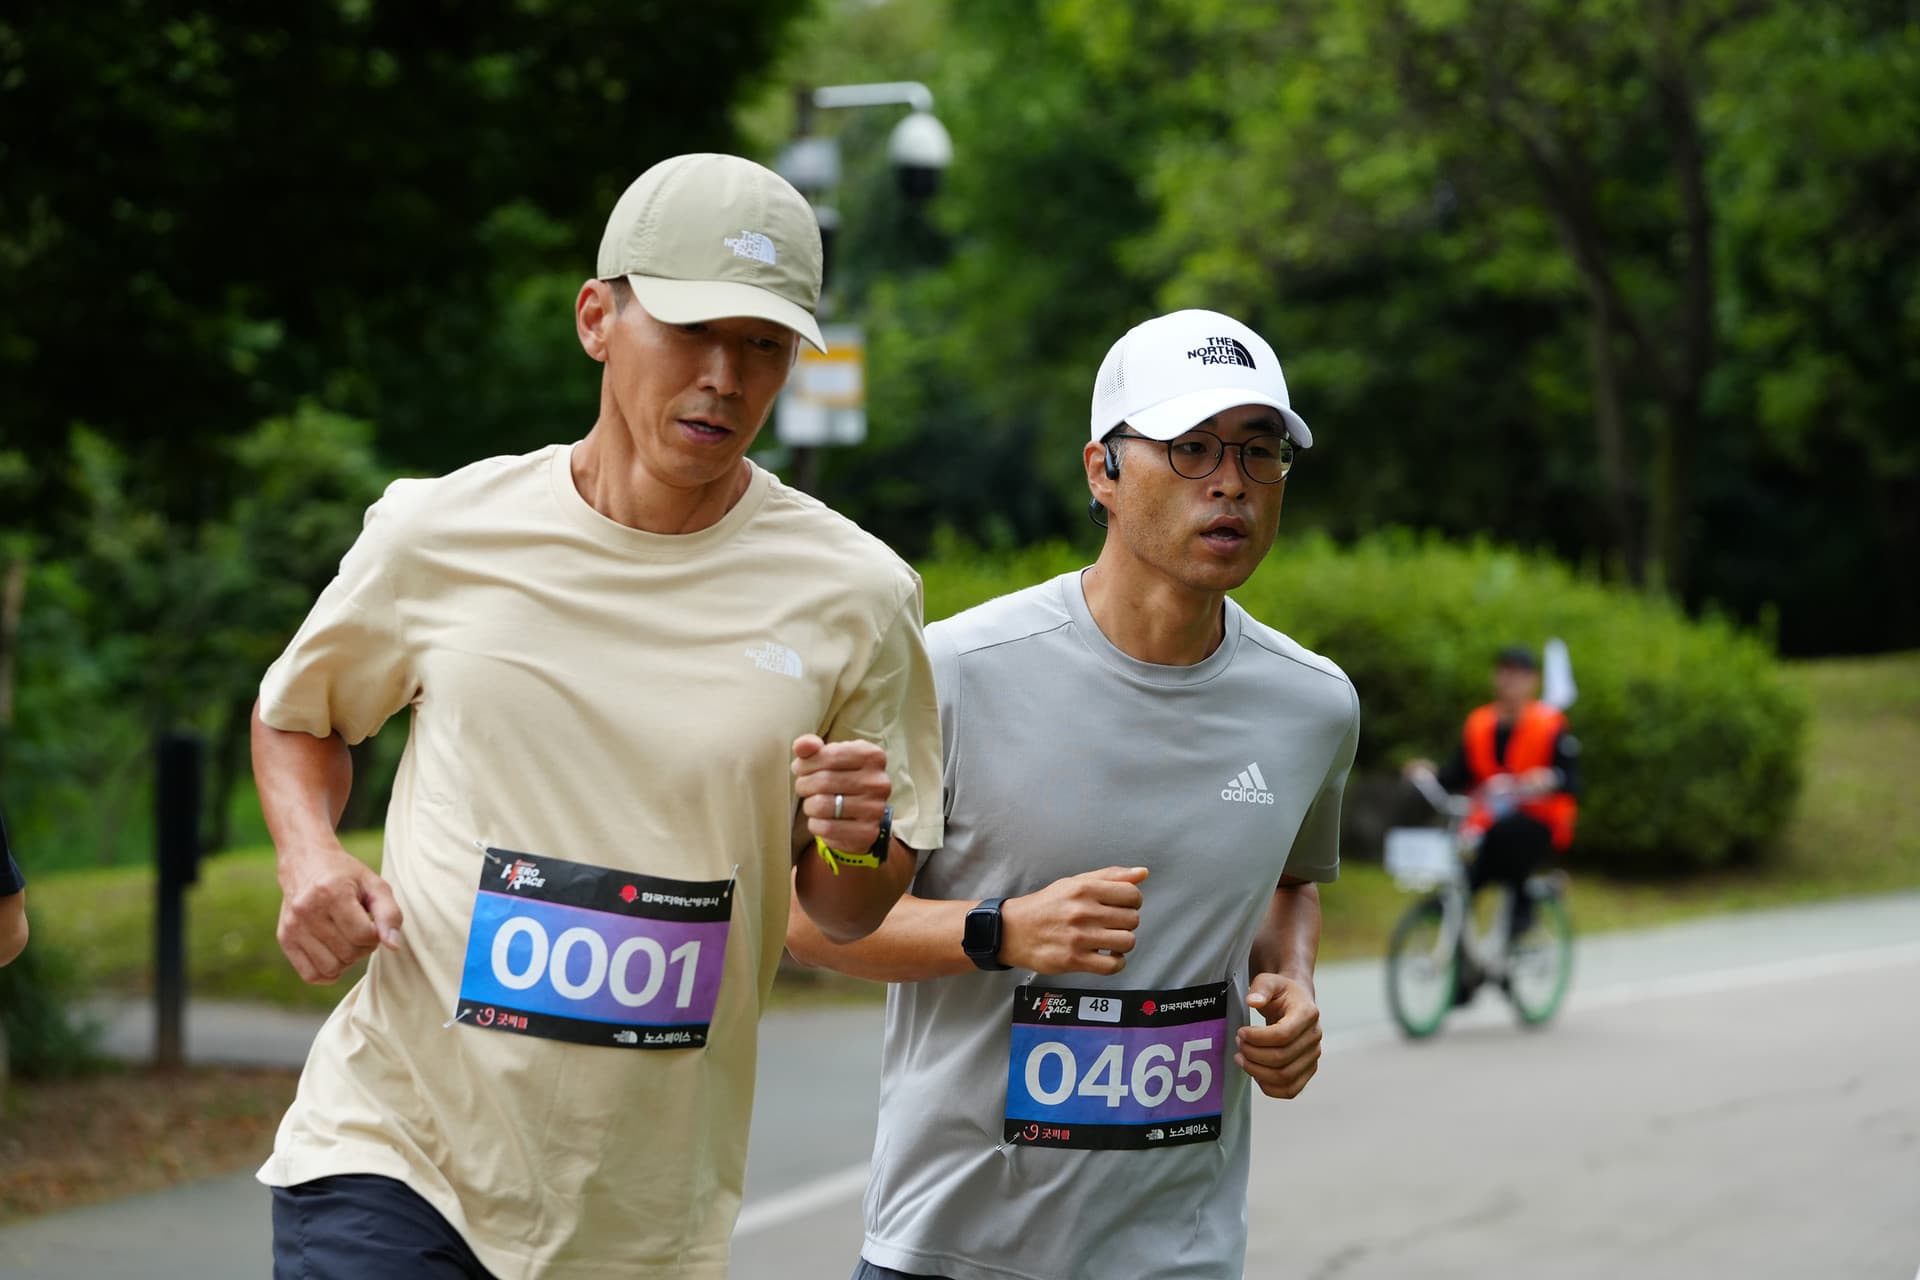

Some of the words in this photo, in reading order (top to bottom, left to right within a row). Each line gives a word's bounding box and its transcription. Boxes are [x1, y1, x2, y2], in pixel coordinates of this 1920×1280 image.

[741, 229, 760, 241] THE
[723, 237, 761, 252] NORTH
[733, 247, 761, 260] FACE
[1206, 336, 1233, 347] THE
[1187, 346, 1235, 359] NORTH
[1202, 355, 1237, 366] FACE
[743, 647, 785, 665] NORTH
[755, 658, 785, 673] FACE
[1221, 787, 1274, 805] adidas
[500, 863, 540, 879] HERO
[511, 875, 546, 890] RACE
[491, 916, 702, 1009] 0001
[1031, 996, 1067, 1010] HERO
[1089, 999, 1109, 1013] 48
[1043, 1005, 1073, 1019] RACE
[643, 1031, 692, 1045] 노스페이스
[1025, 1037, 1213, 1108] 0465
[1169, 1123, 1209, 1138] 노스페이스
